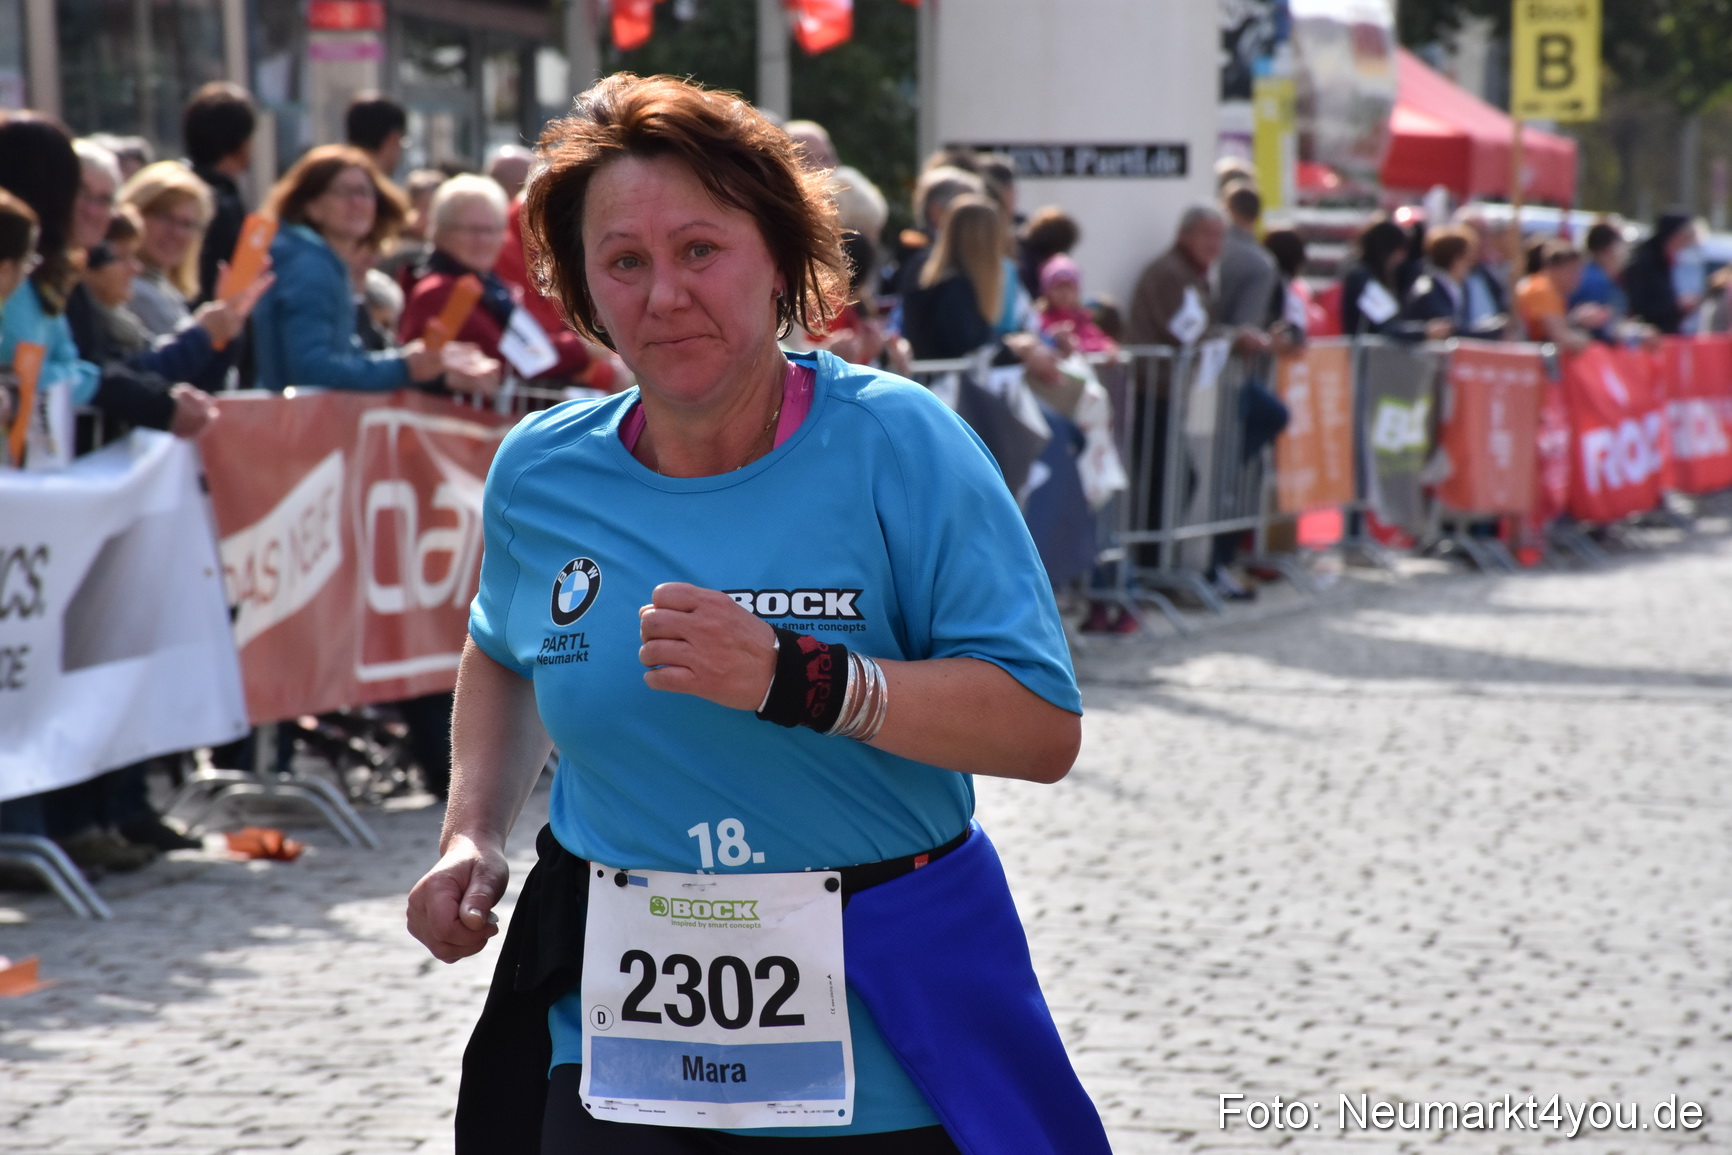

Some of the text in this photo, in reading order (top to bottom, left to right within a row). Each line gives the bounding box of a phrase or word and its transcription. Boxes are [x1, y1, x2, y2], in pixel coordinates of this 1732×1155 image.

[1537, 34, 1577, 92] B
[557, 560, 599, 584] BMW
[782, 622, 815, 632] smart
[818, 622, 866, 633] concepts
[540, 632, 590, 653] PARTL
[536, 650, 589, 665] Neumarkt
[687, 817, 765, 869] 18.
[670, 897, 760, 921] BOCK
[671, 919, 697, 930] inspired
[698, 920, 707, 929] by
[729, 922, 761, 930] concepts
[619, 949, 806, 1030] 2302
[597, 1011, 606, 1025] D
[681, 1054, 747, 1084] Mara
